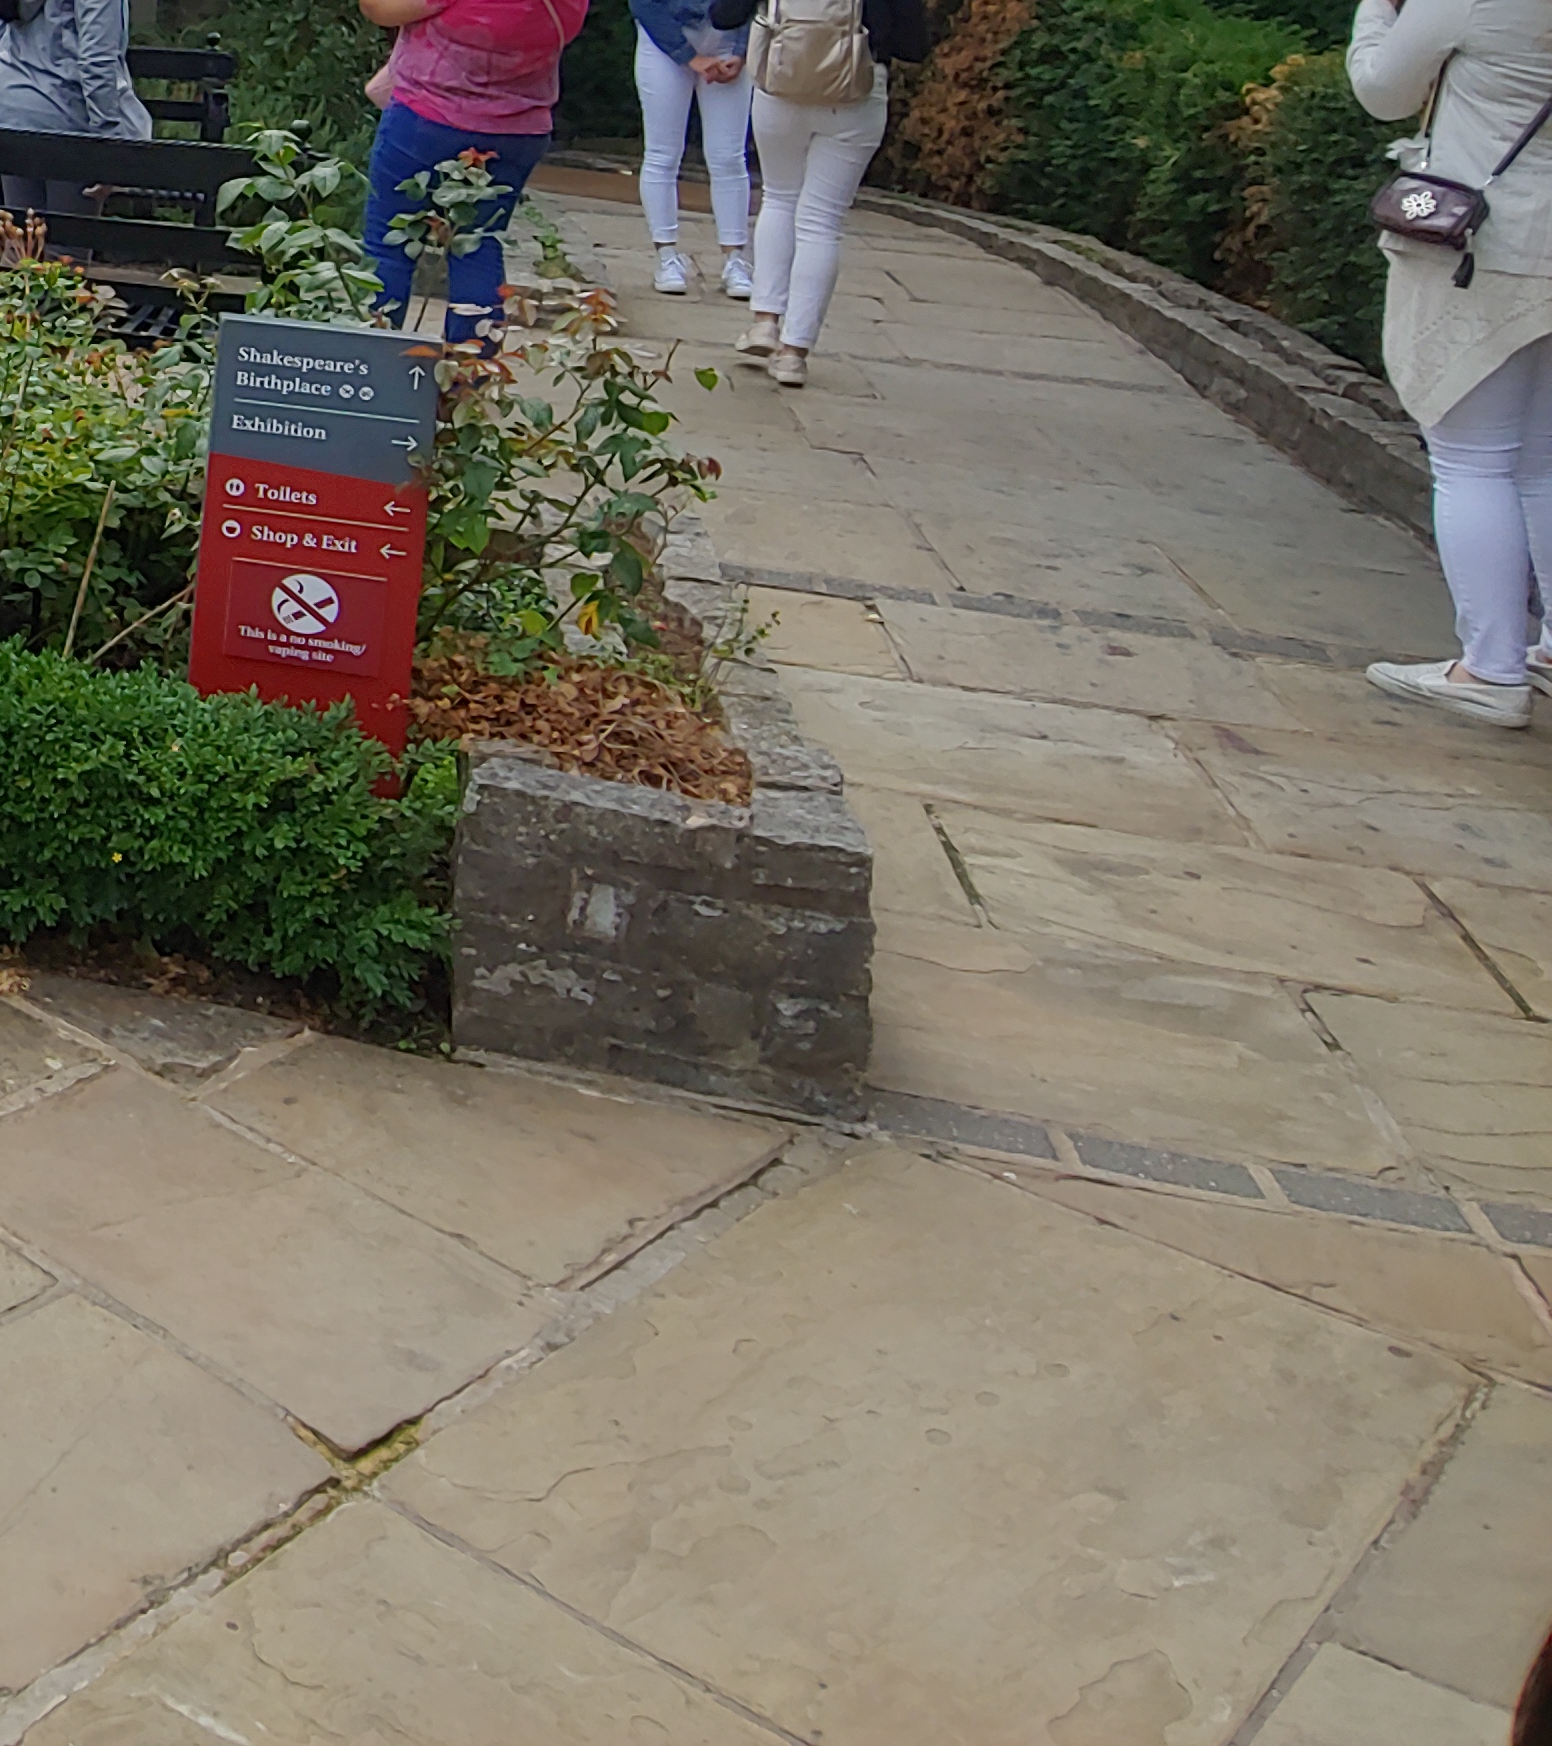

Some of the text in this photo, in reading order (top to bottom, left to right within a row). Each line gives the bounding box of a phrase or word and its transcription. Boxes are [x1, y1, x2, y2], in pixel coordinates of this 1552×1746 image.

[238, 346, 369, 375] Shakespeare's
[236, 370, 331, 396] Birthplace
[231, 414, 327, 440] Exhibition
[254, 483, 317, 505] Toilets
[251, 525, 357, 553] Shop & Exit
[238, 625, 264, 639] This
[279, 634, 287, 642] a
[289, 635, 306, 645] no
[268, 645, 334, 662] vaping site
